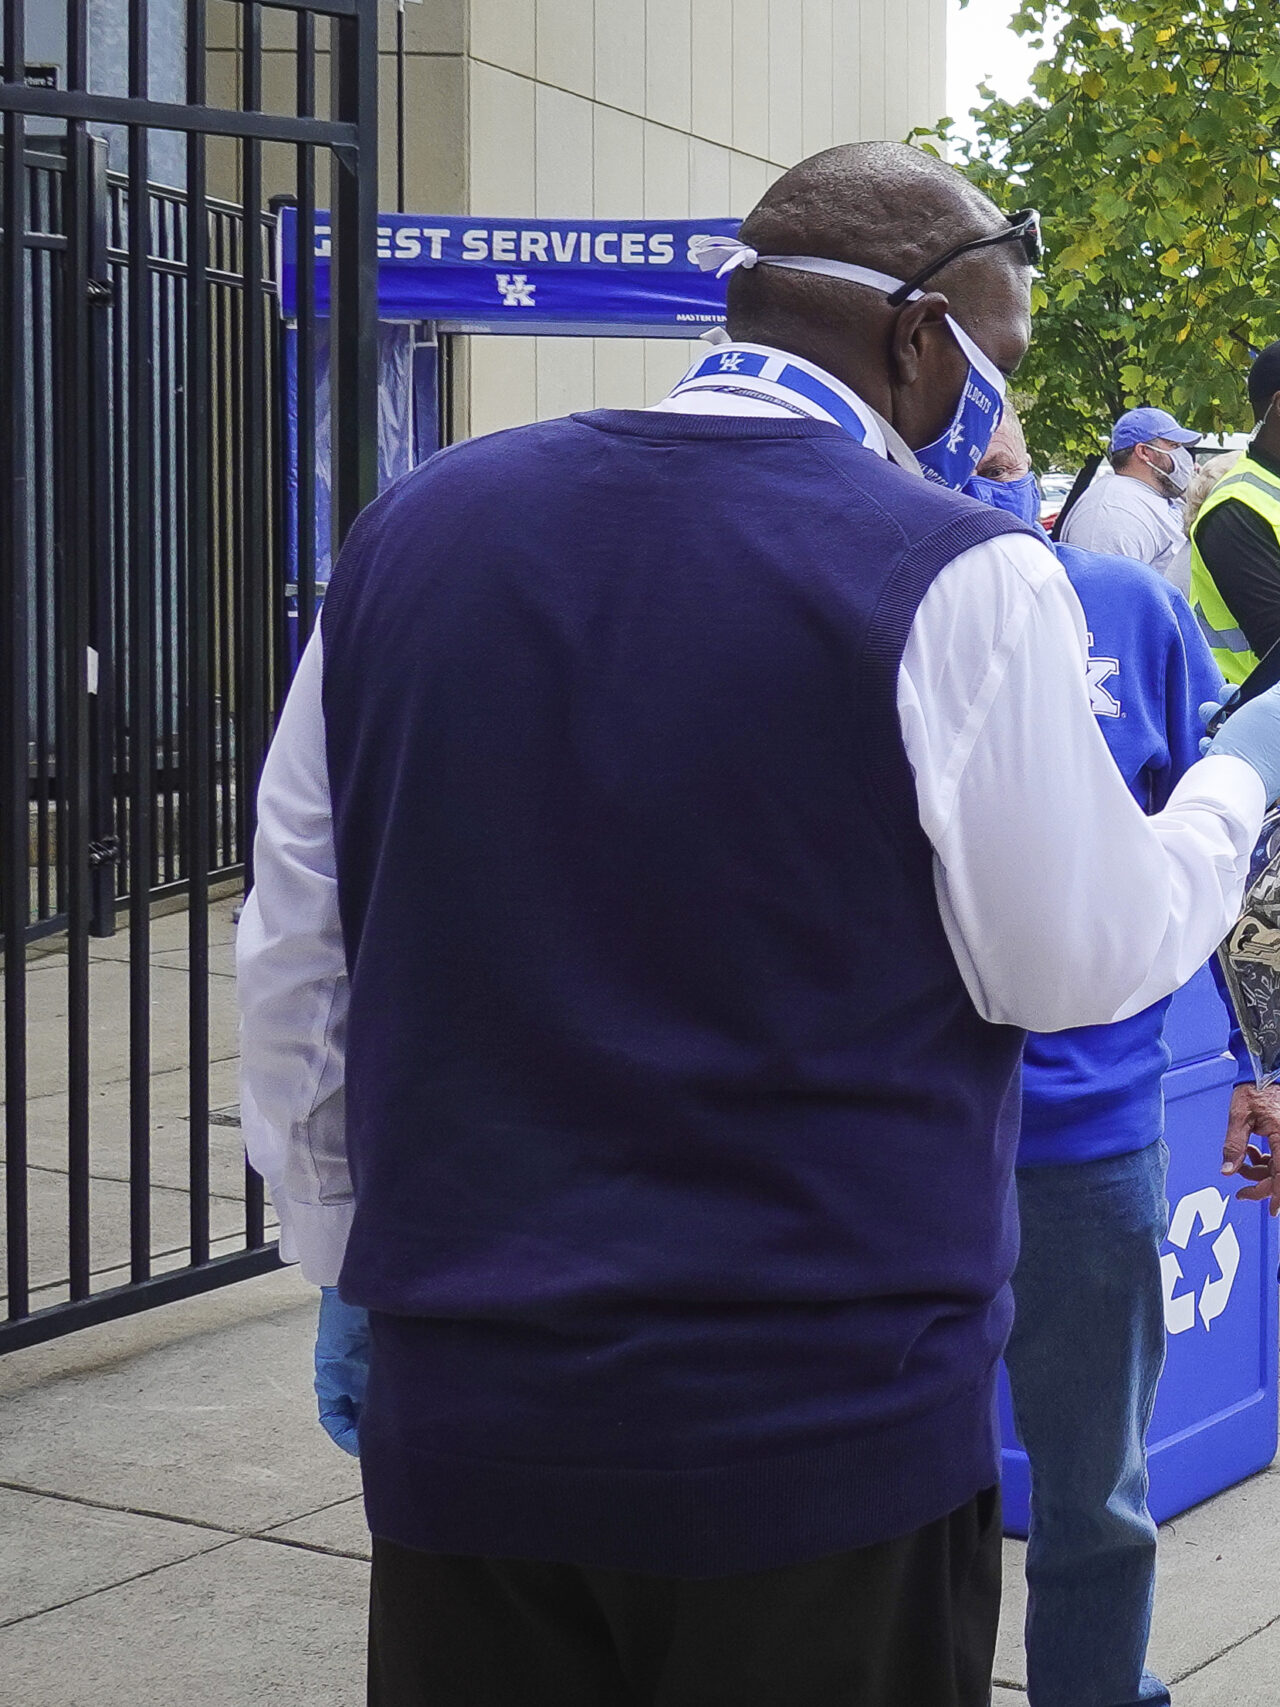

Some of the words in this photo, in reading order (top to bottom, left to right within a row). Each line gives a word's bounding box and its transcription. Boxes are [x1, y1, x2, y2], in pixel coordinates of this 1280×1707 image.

[313, 225, 451, 260] GEST
[461, 229, 675, 266] SERVICES
[495, 273, 537, 306] UK
[719, 352, 745, 371] UK
[1086, 631, 1121, 718] K
